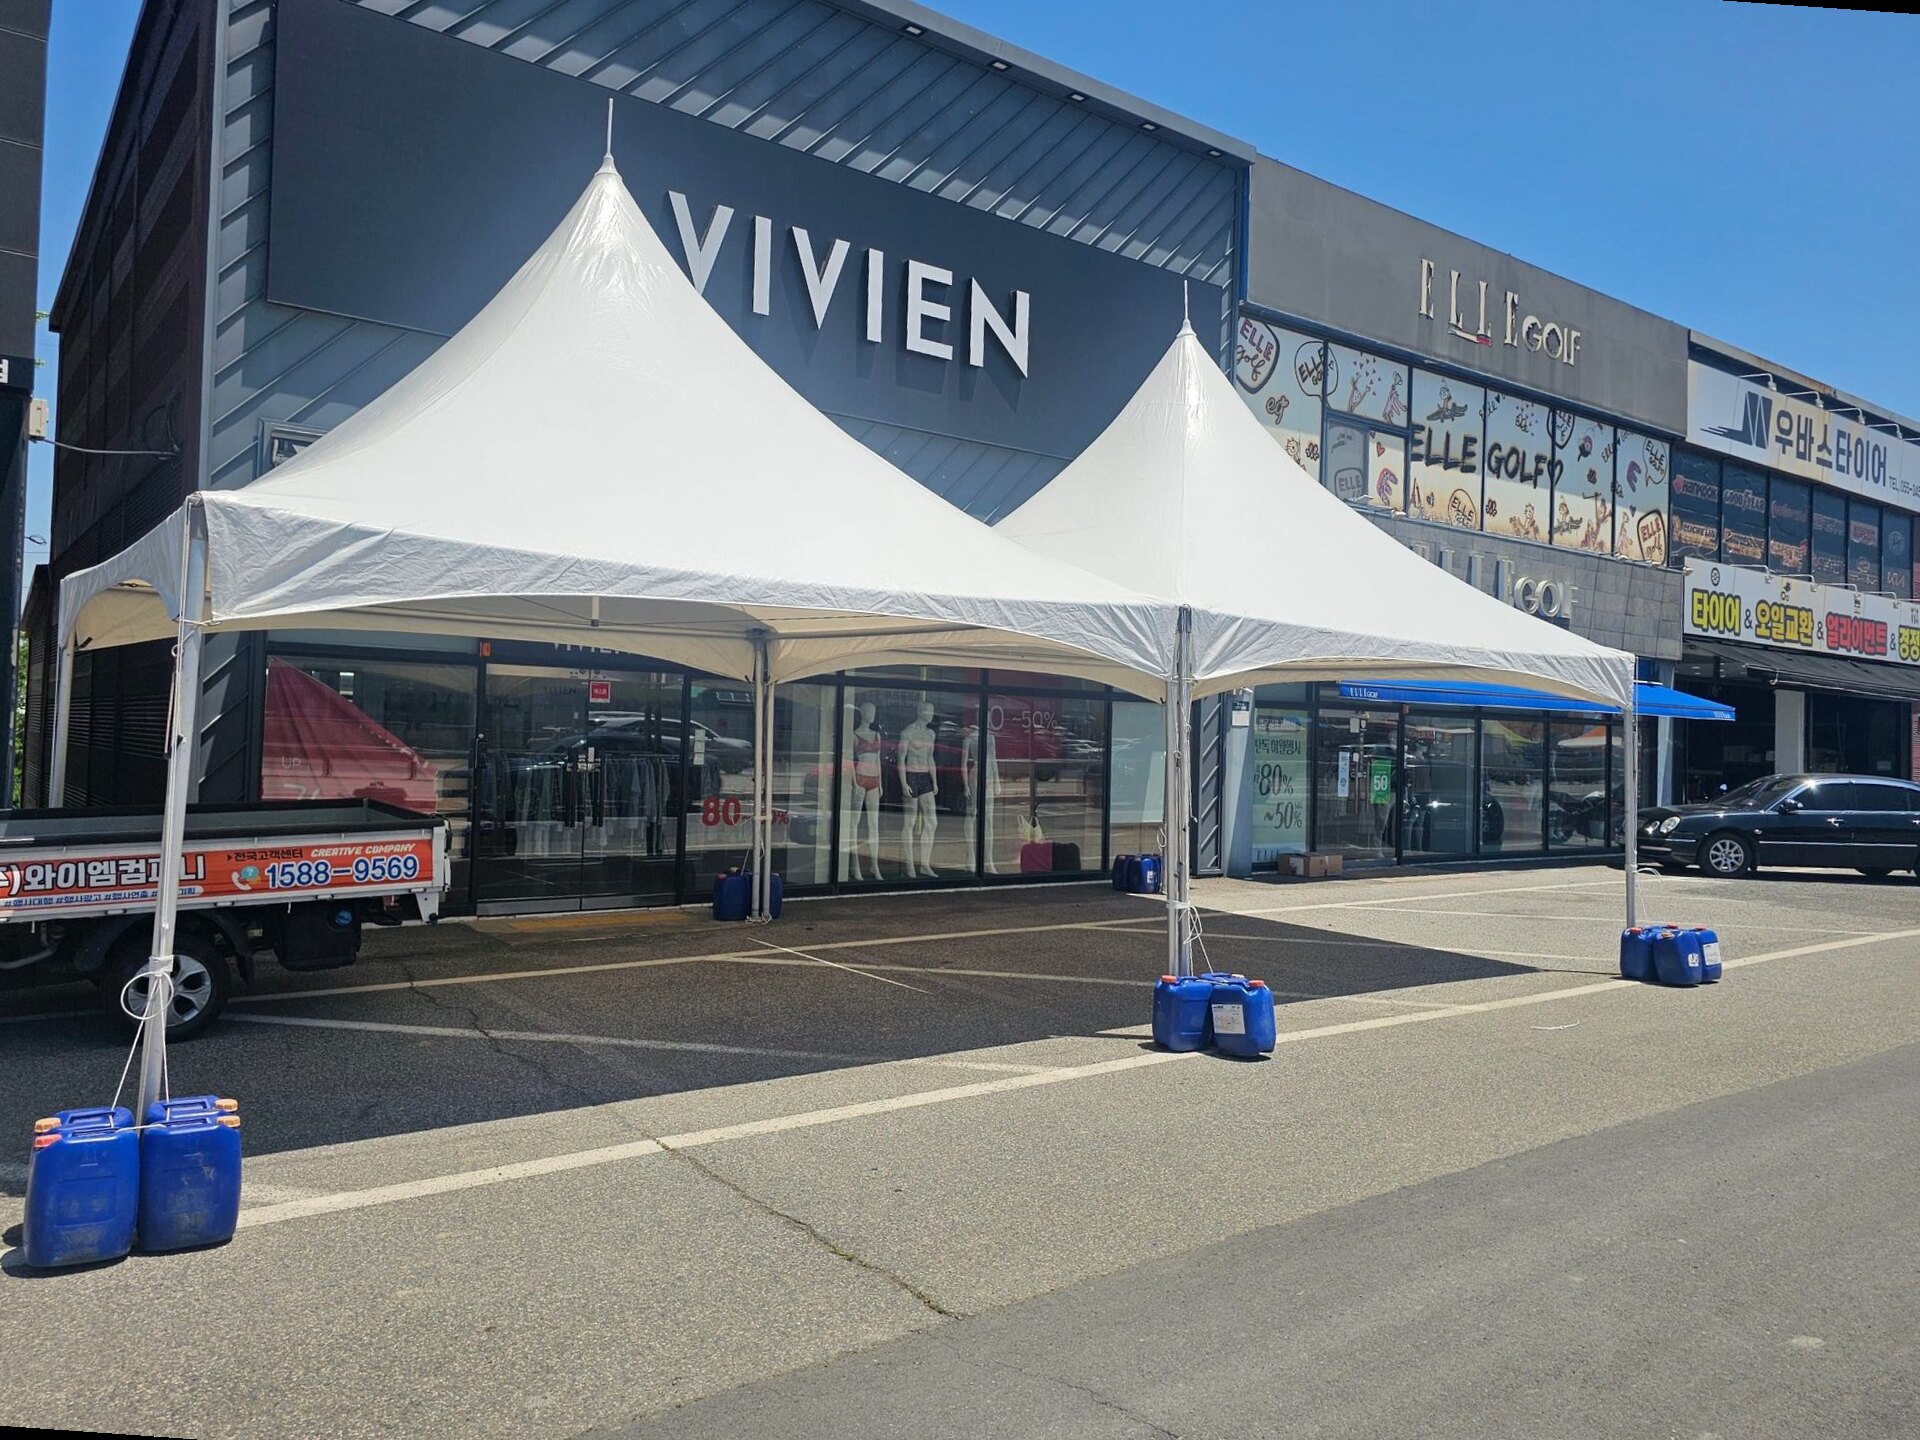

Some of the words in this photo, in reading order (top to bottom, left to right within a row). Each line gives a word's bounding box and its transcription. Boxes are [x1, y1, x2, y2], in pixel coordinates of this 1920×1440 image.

[668, 190, 1030, 379] VIVIEN
[1419, 258, 1519, 347] ELLE
[1522, 315, 1581, 366] GOLF
[1240, 319, 1275, 362] ELLE
[1409, 424, 1478, 473] ELLE
[1487, 442, 1548, 489] GOLF
[1774, 409, 1888, 487] 우바스타이어
[1338, 475, 1361, 492] ELLE
[1692, 588, 1741, 636] 타이어
[1744, 608, 1753, 630] &
[1755, 600, 1813, 647] 오일교환
[1817, 621, 1824, 641] &
[1826, 612, 1888, 657] 얼라이먼트
[1890, 632, 1896, 651] &
[1260, 764, 1294, 796] 80%
[1374, 775, 1388, 791] 50
[702, 795, 741, 827] 80
[234, 849, 303, 862] 전국고객센터
[311, 845, 362, 858] CREATIVE
[365, 843, 416, 855] COMPANY
[265, 855, 418, 889] 1588-9569
